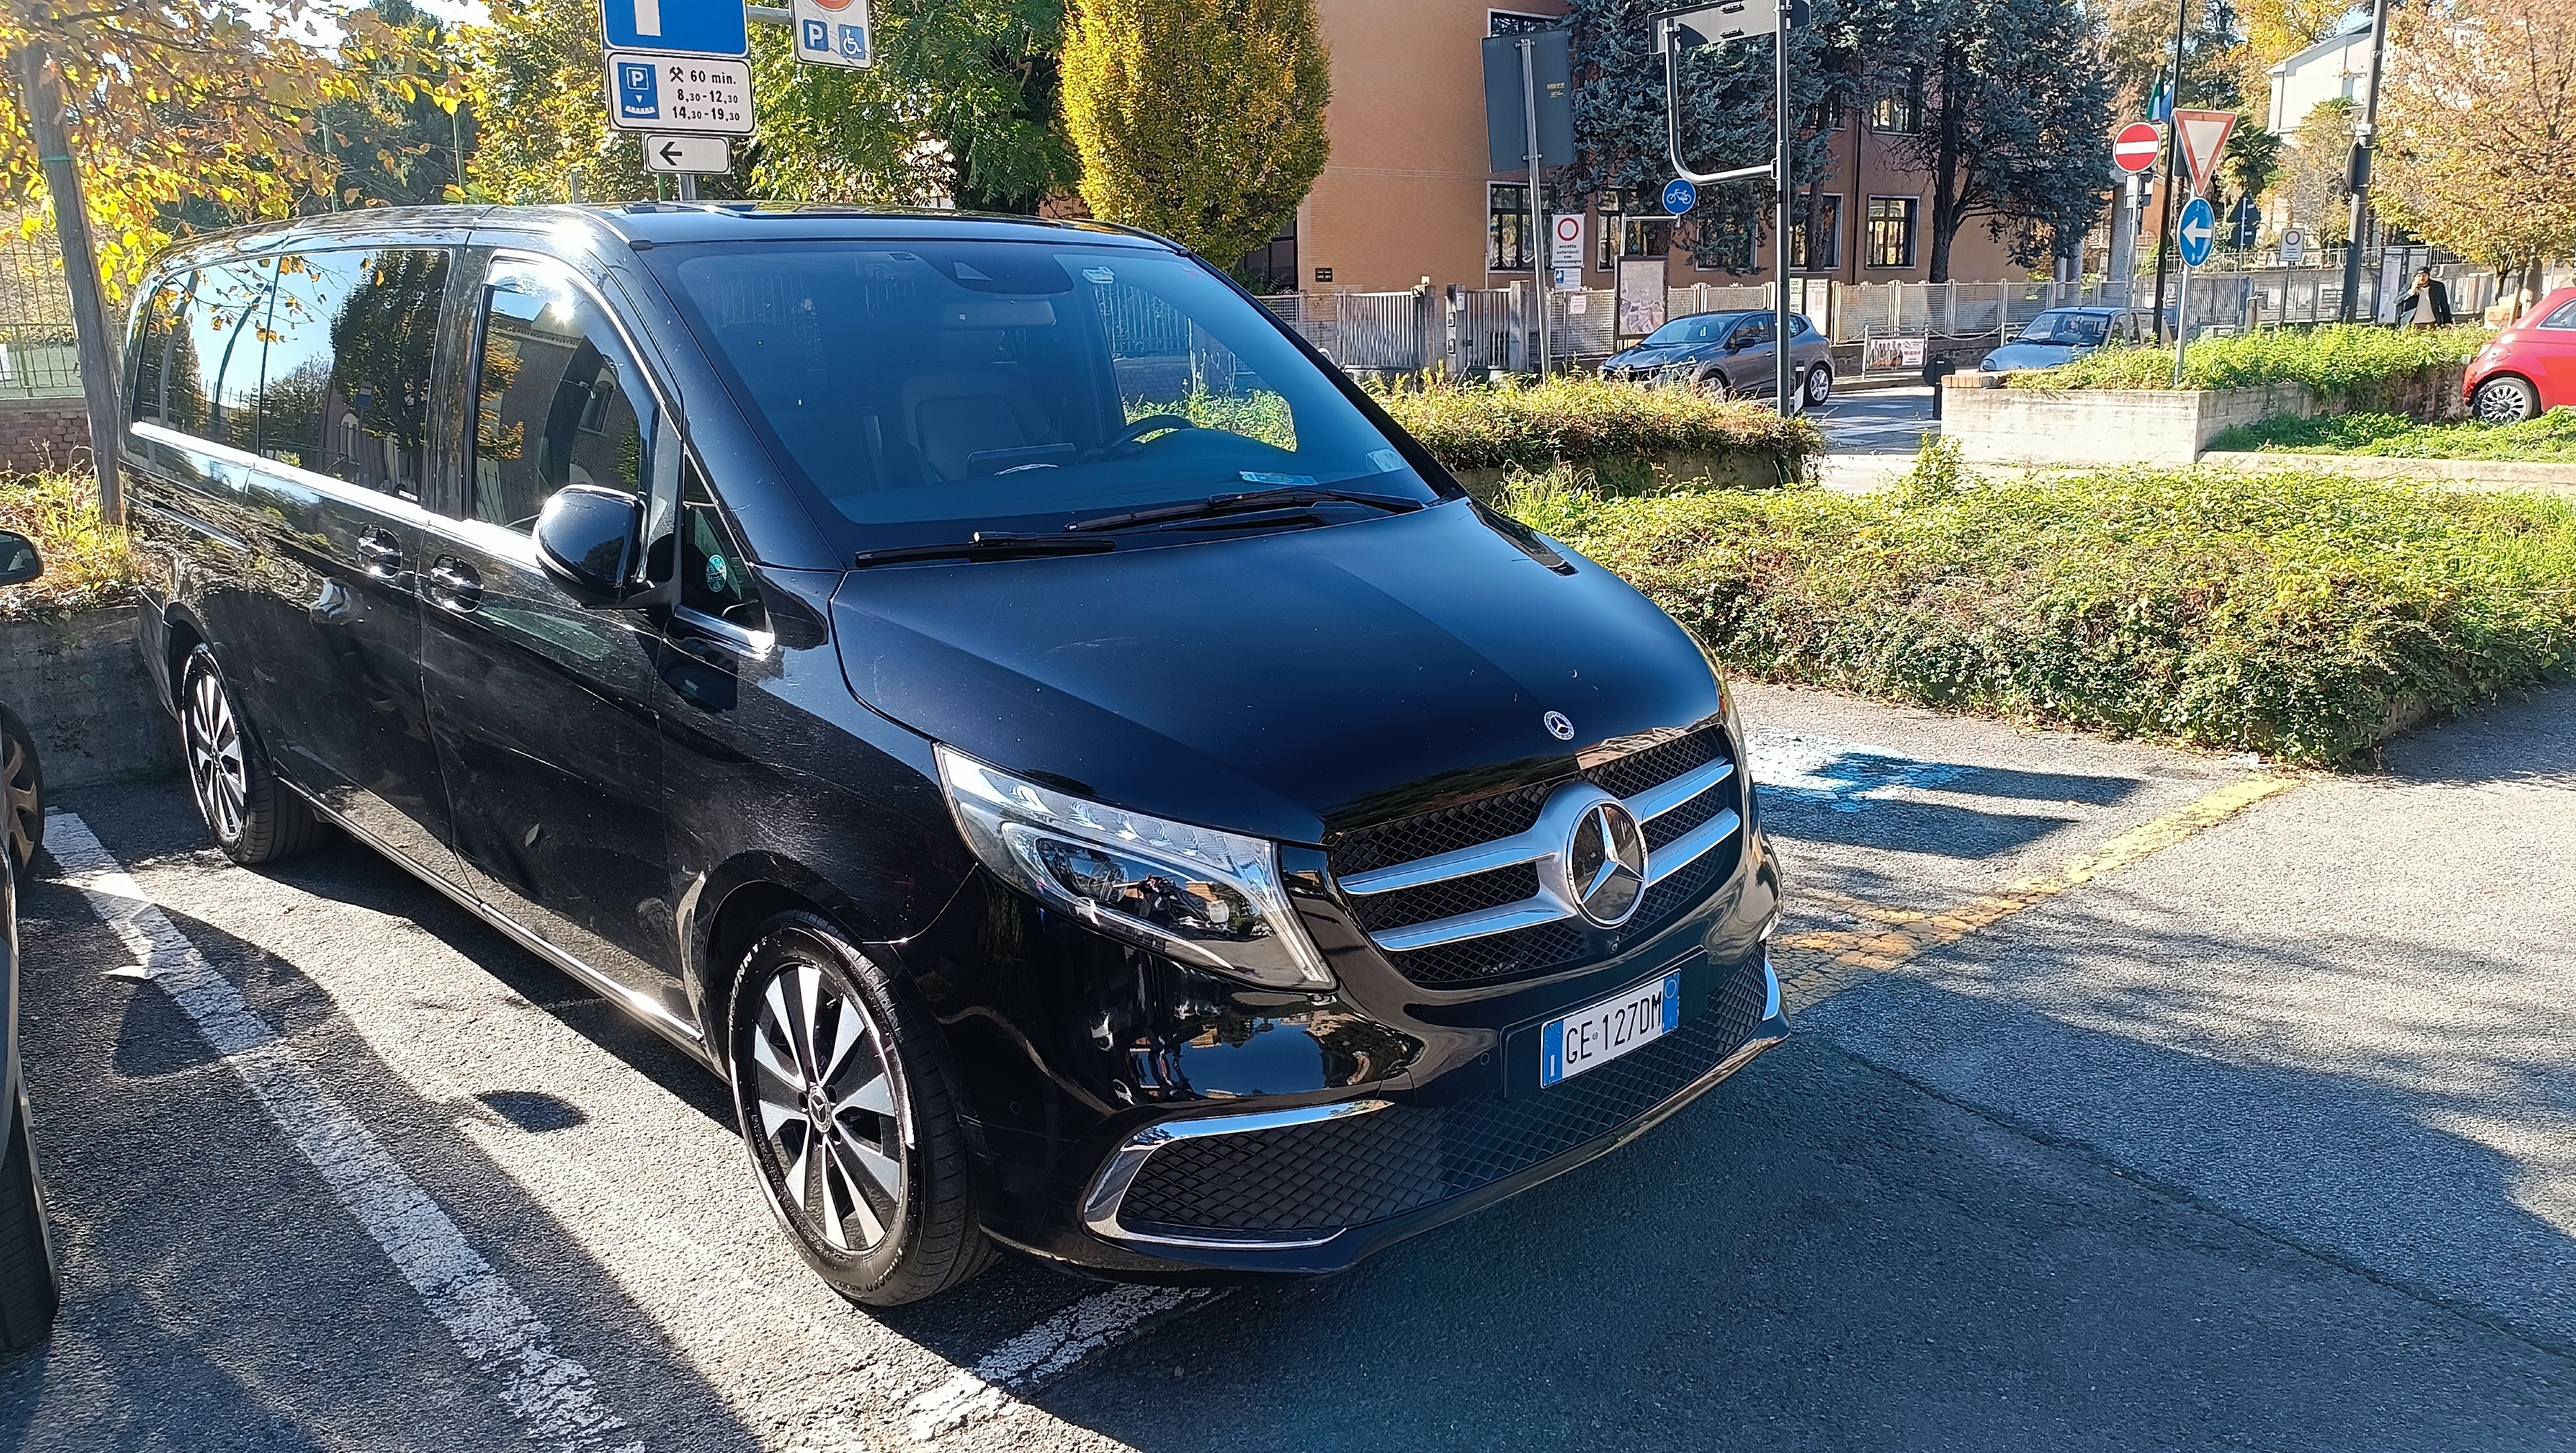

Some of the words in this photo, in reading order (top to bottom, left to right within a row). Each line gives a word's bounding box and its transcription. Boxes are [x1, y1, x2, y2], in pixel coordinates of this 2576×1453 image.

[808, 23, 824, 47] P
[631, 70, 644, 87] P
[690, 70, 706, 82] 60
